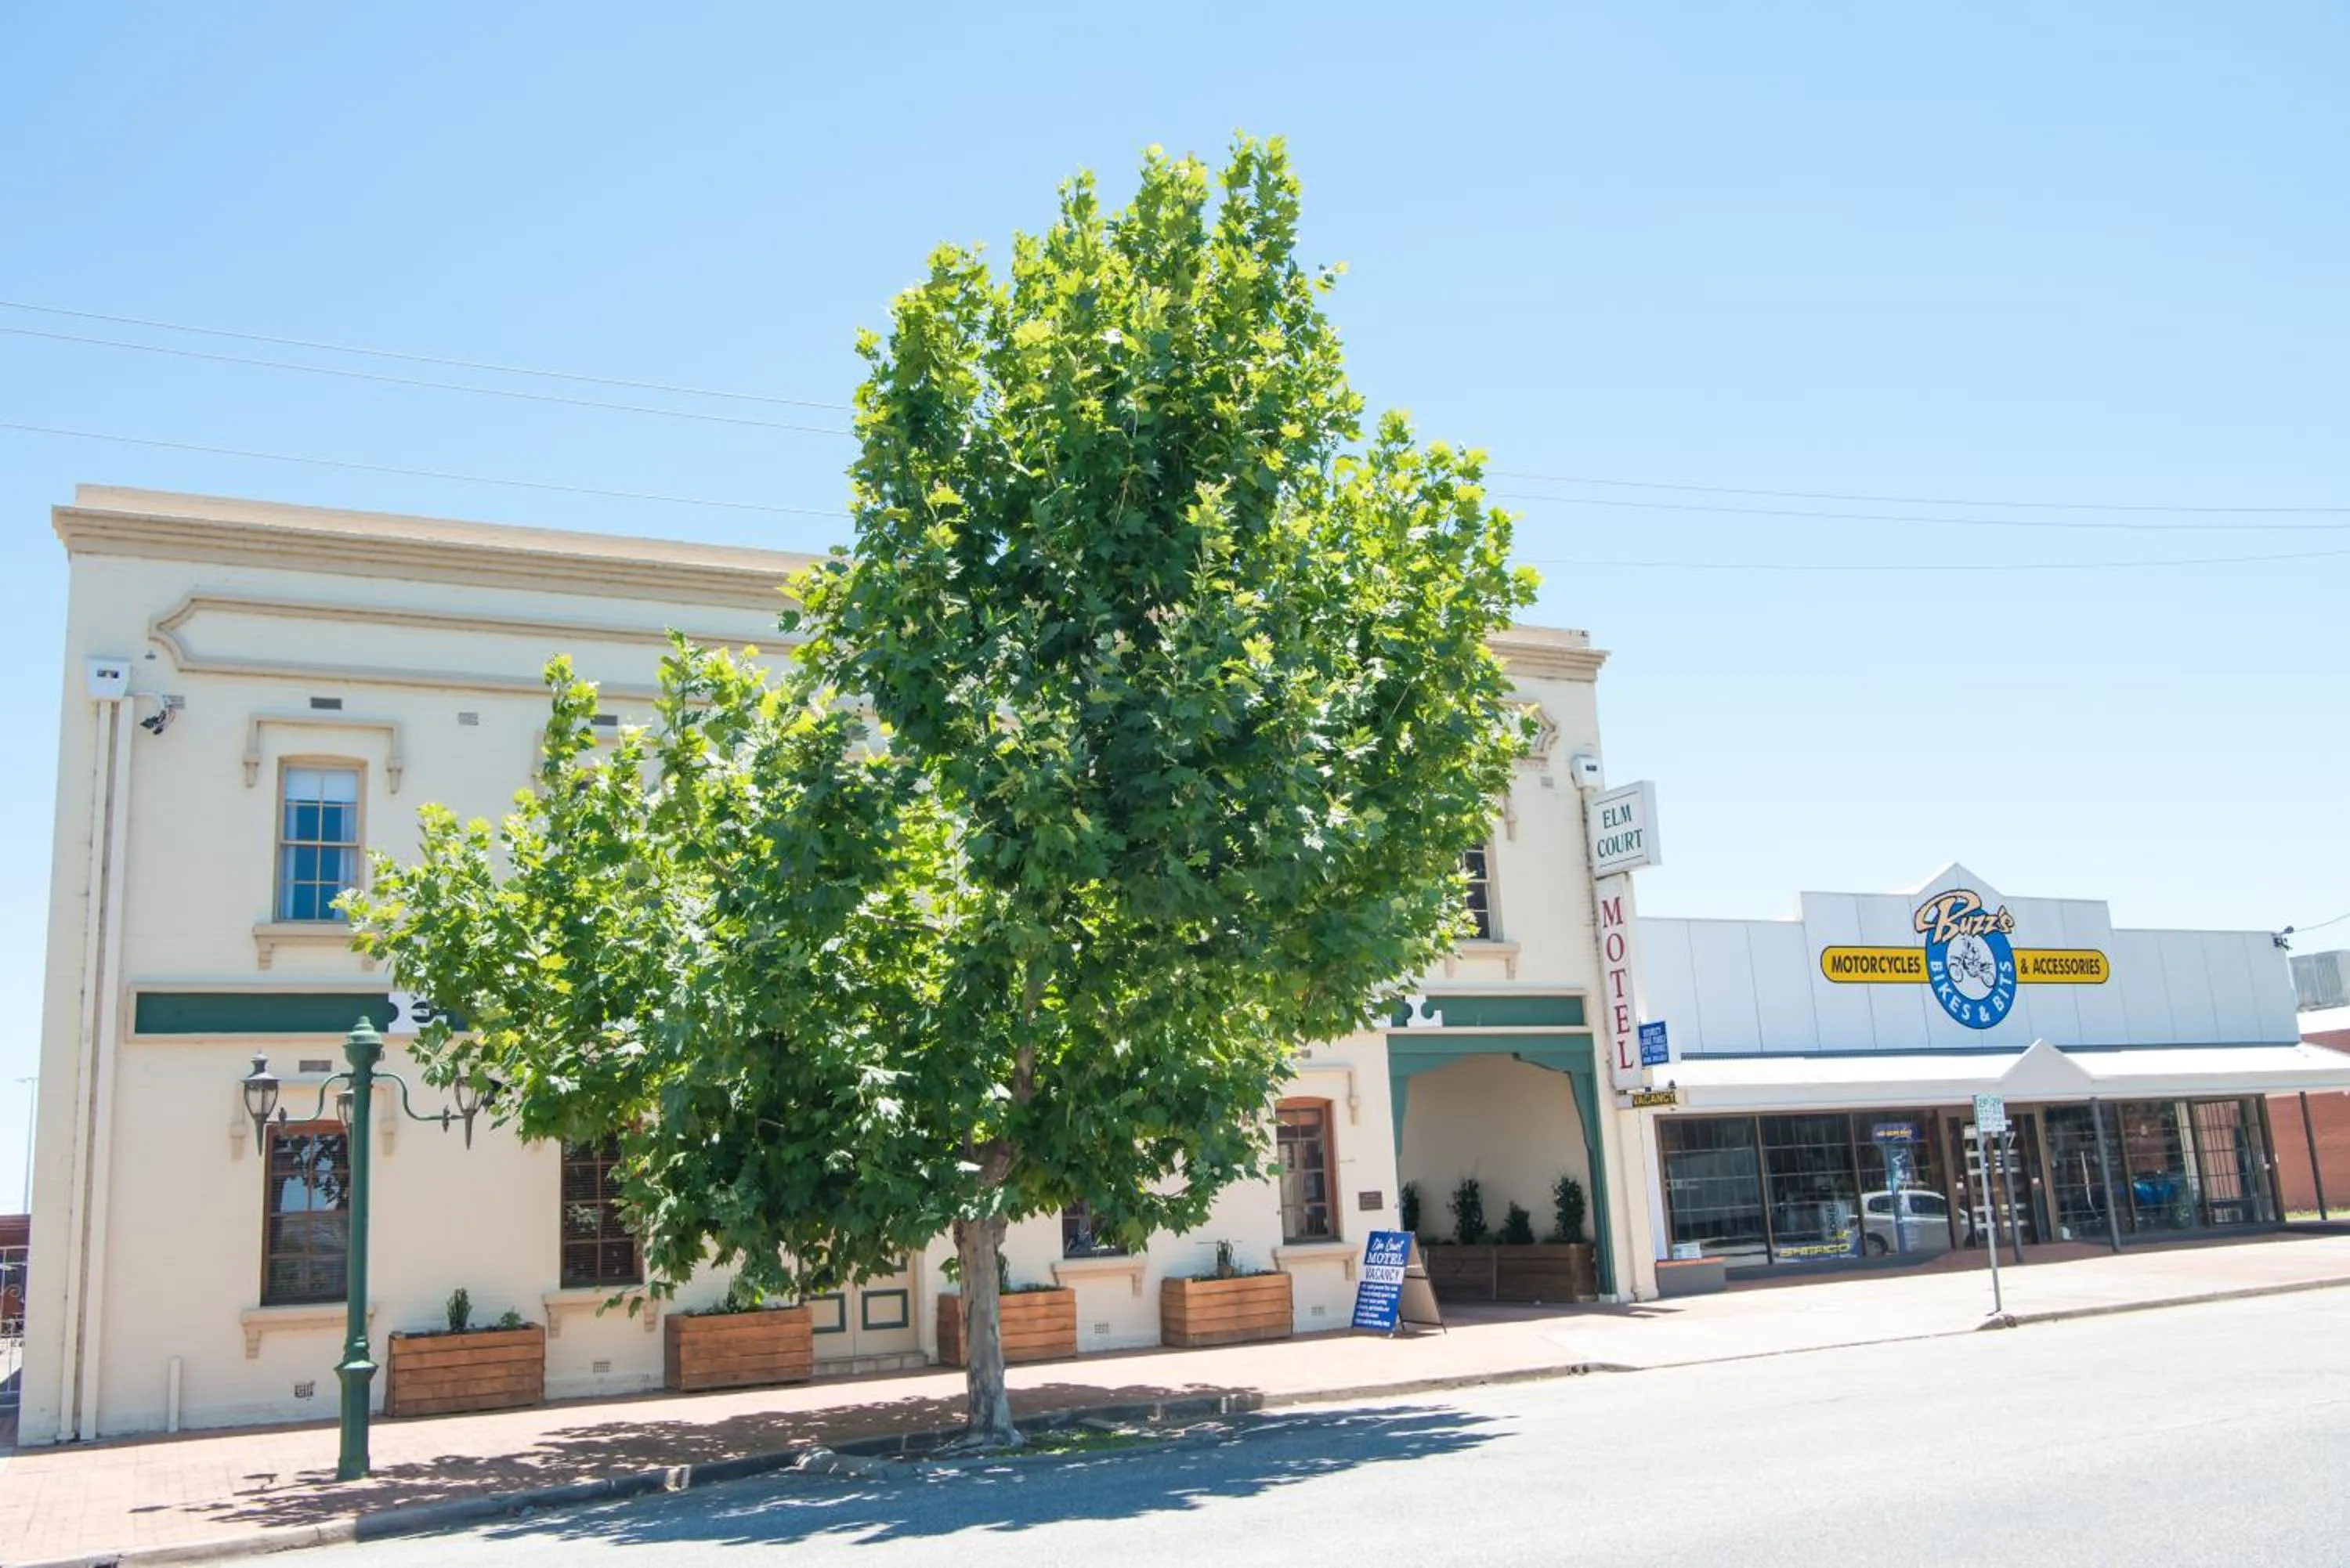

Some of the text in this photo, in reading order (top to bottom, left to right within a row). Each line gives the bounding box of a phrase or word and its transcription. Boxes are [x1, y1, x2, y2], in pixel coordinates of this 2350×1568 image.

[1603, 804, 1632, 829] ELM
[1597, 828, 1643, 858] COURT
[1914, 889, 2015, 945] Buzz's
[1831, 955, 1922, 974] MOTORCYCLES
[2020, 957, 2101, 975] & ACCESSORIES
[1602, 896, 1635, 1069] MOTEL
[1930, 961, 2012, 1022] BIKES & BITS
[1366, 1252, 1405, 1265] MOTEL
[1365, 1266, 1401, 1281] VACANCY
